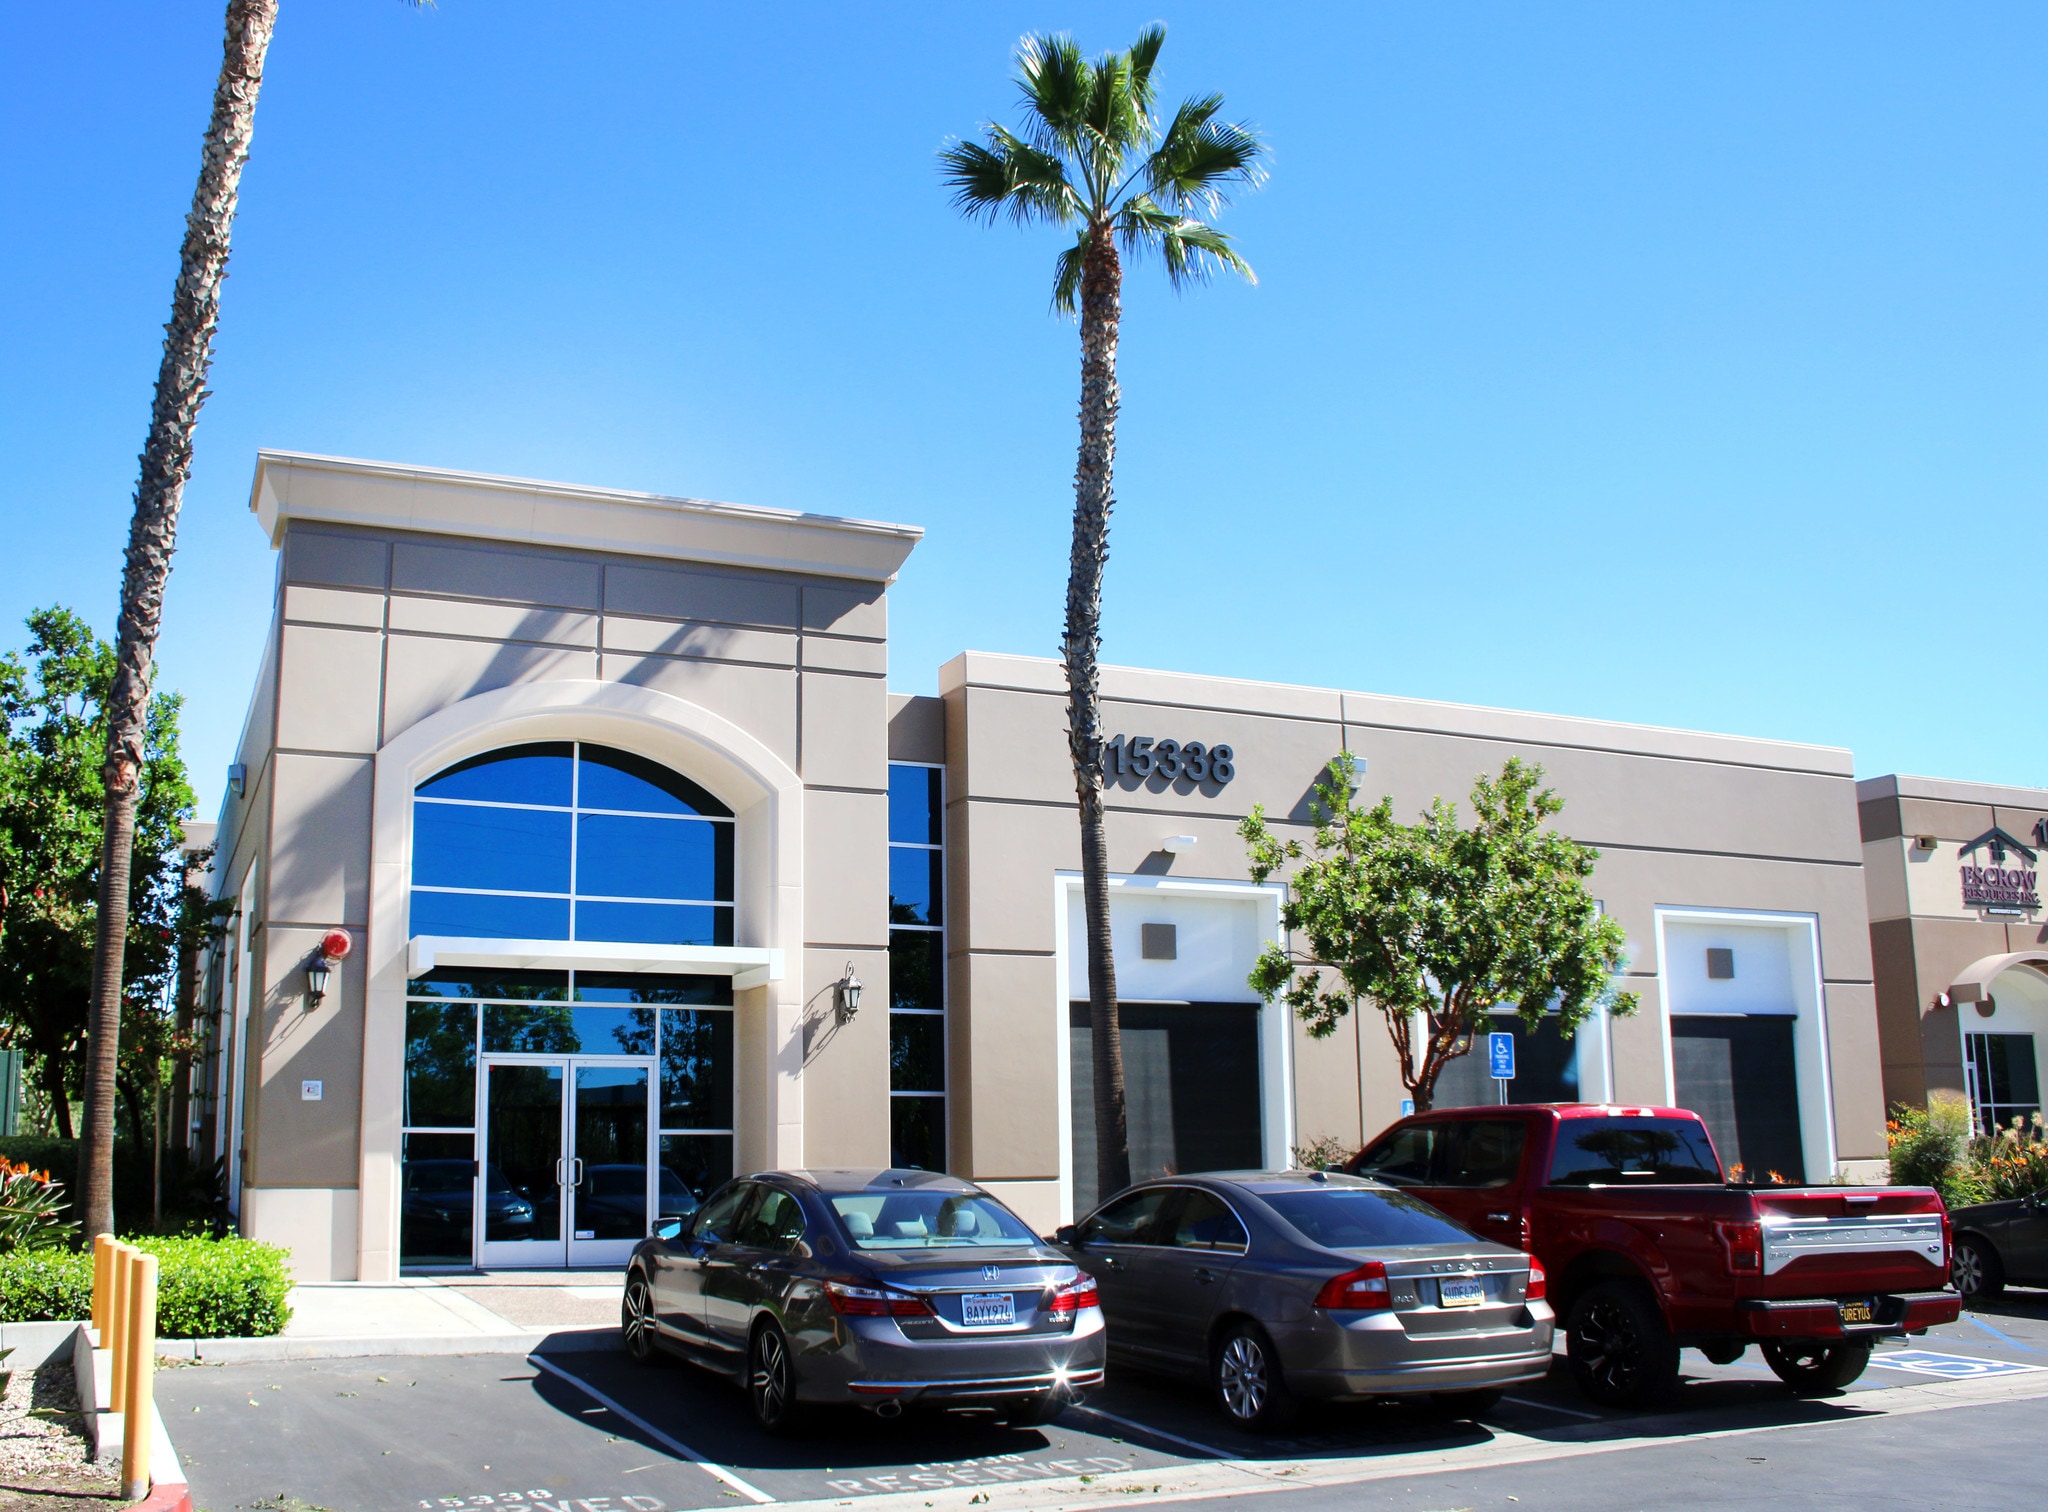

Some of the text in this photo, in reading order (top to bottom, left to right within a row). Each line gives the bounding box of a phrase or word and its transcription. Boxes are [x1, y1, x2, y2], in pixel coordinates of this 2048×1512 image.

[1106, 734, 1235, 783] 15338
[1961, 866, 2037, 890] ESCROW
[1964, 887, 2019, 902] RESOURCES
[825, 1456, 1134, 1494] RESERVED
[418, 1489, 553, 1508] 15338
